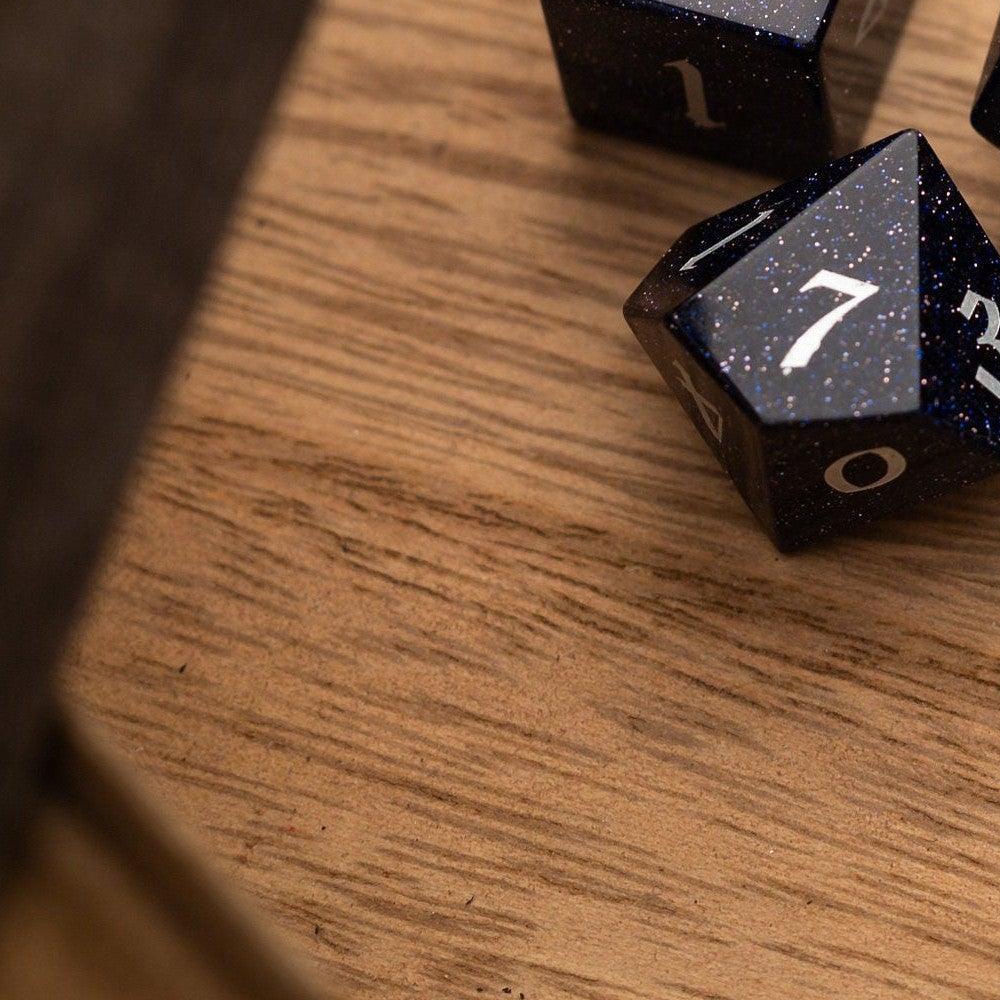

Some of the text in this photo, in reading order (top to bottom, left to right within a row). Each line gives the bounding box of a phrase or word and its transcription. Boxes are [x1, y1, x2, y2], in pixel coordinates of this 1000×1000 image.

[659, 57, 726, 130] 1
[780, 269, 880, 376] 7
[824, 446, 907, 494] 0
